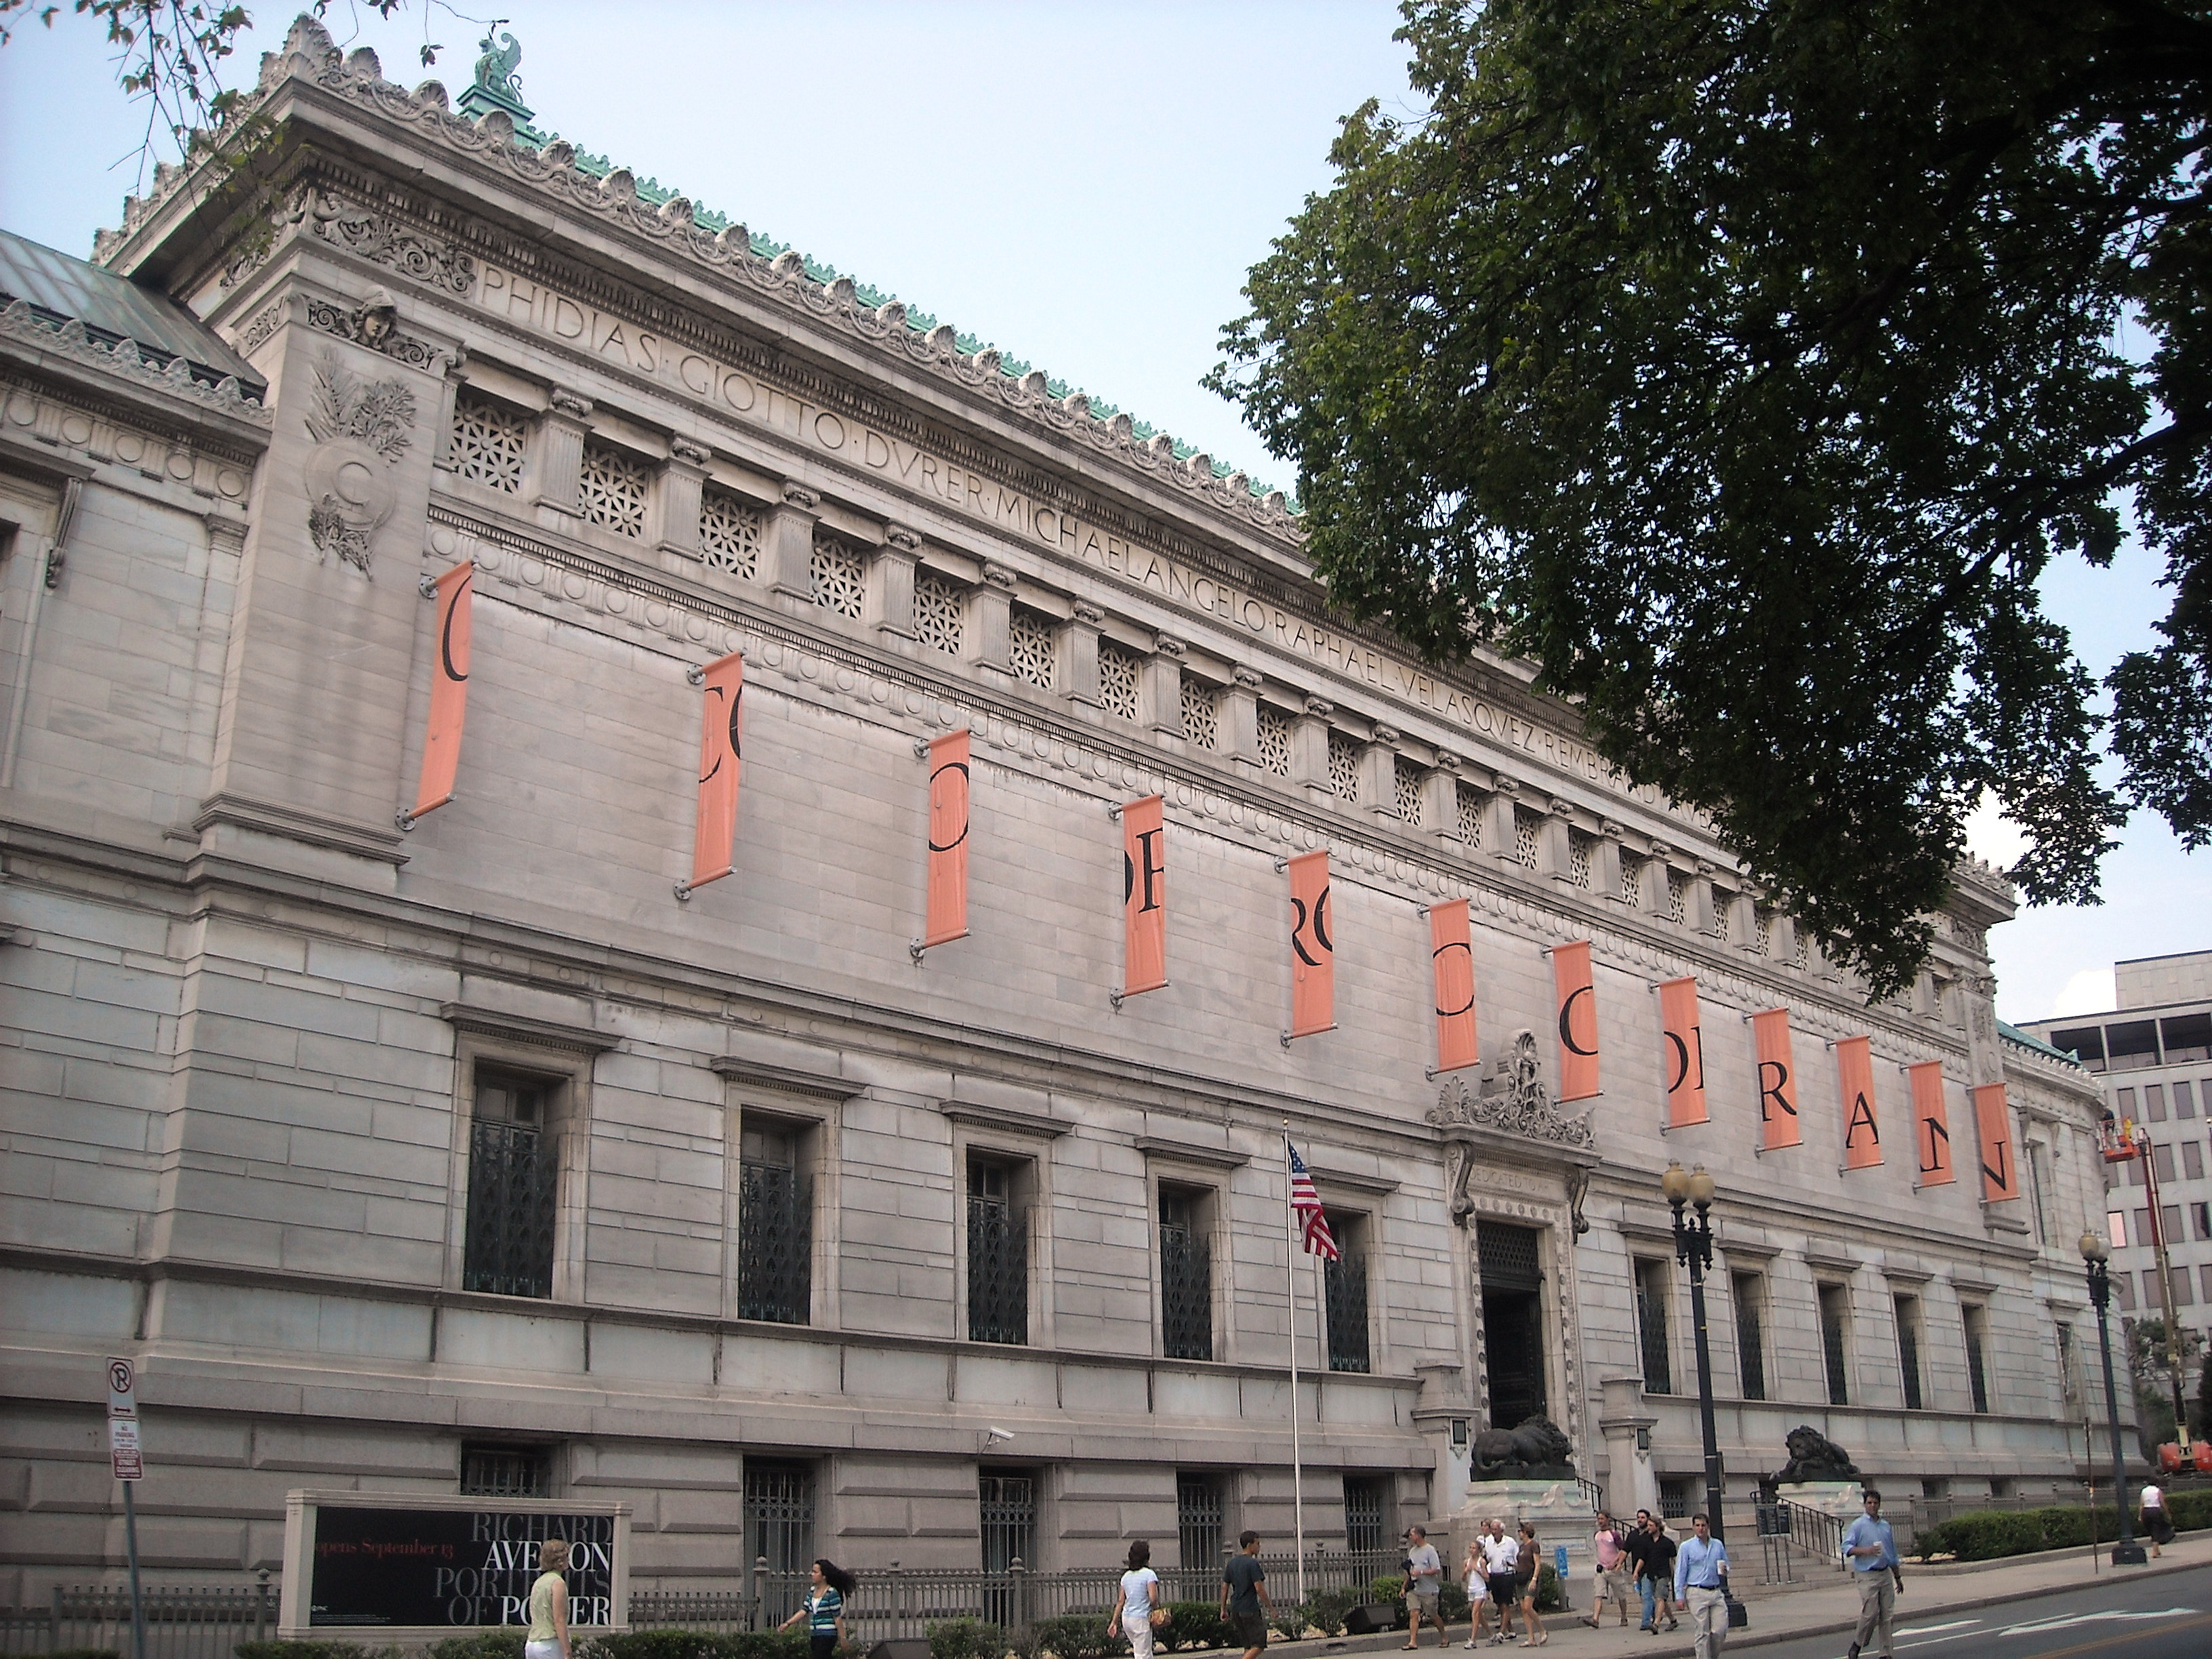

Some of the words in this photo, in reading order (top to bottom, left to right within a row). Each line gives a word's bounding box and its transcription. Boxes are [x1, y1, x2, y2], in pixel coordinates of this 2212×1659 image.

[482, 266, 657, 372] PHIDIAS
[680, 354, 845, 449] GIOTTO
[864, 430, 987, 514] DVRER
[995, 487, 1266, 632] MICHAELANGELO
[1273, 615, 1397, 691] RAPHAEL
[1397, 665, 1535, 752] VELASQVEZ
[471, 1513, 611, 1544] RICHARD
[361, 1538, 437, 1559] September
[441, 1544, 454, 1559] 13
[481, 1540, 612, 1572] AVEON
[434, 1567, 610, 1597] PORTITS
[448, 1595, 493, 1626] OF
[499, 1596, 609, 1626] PER
